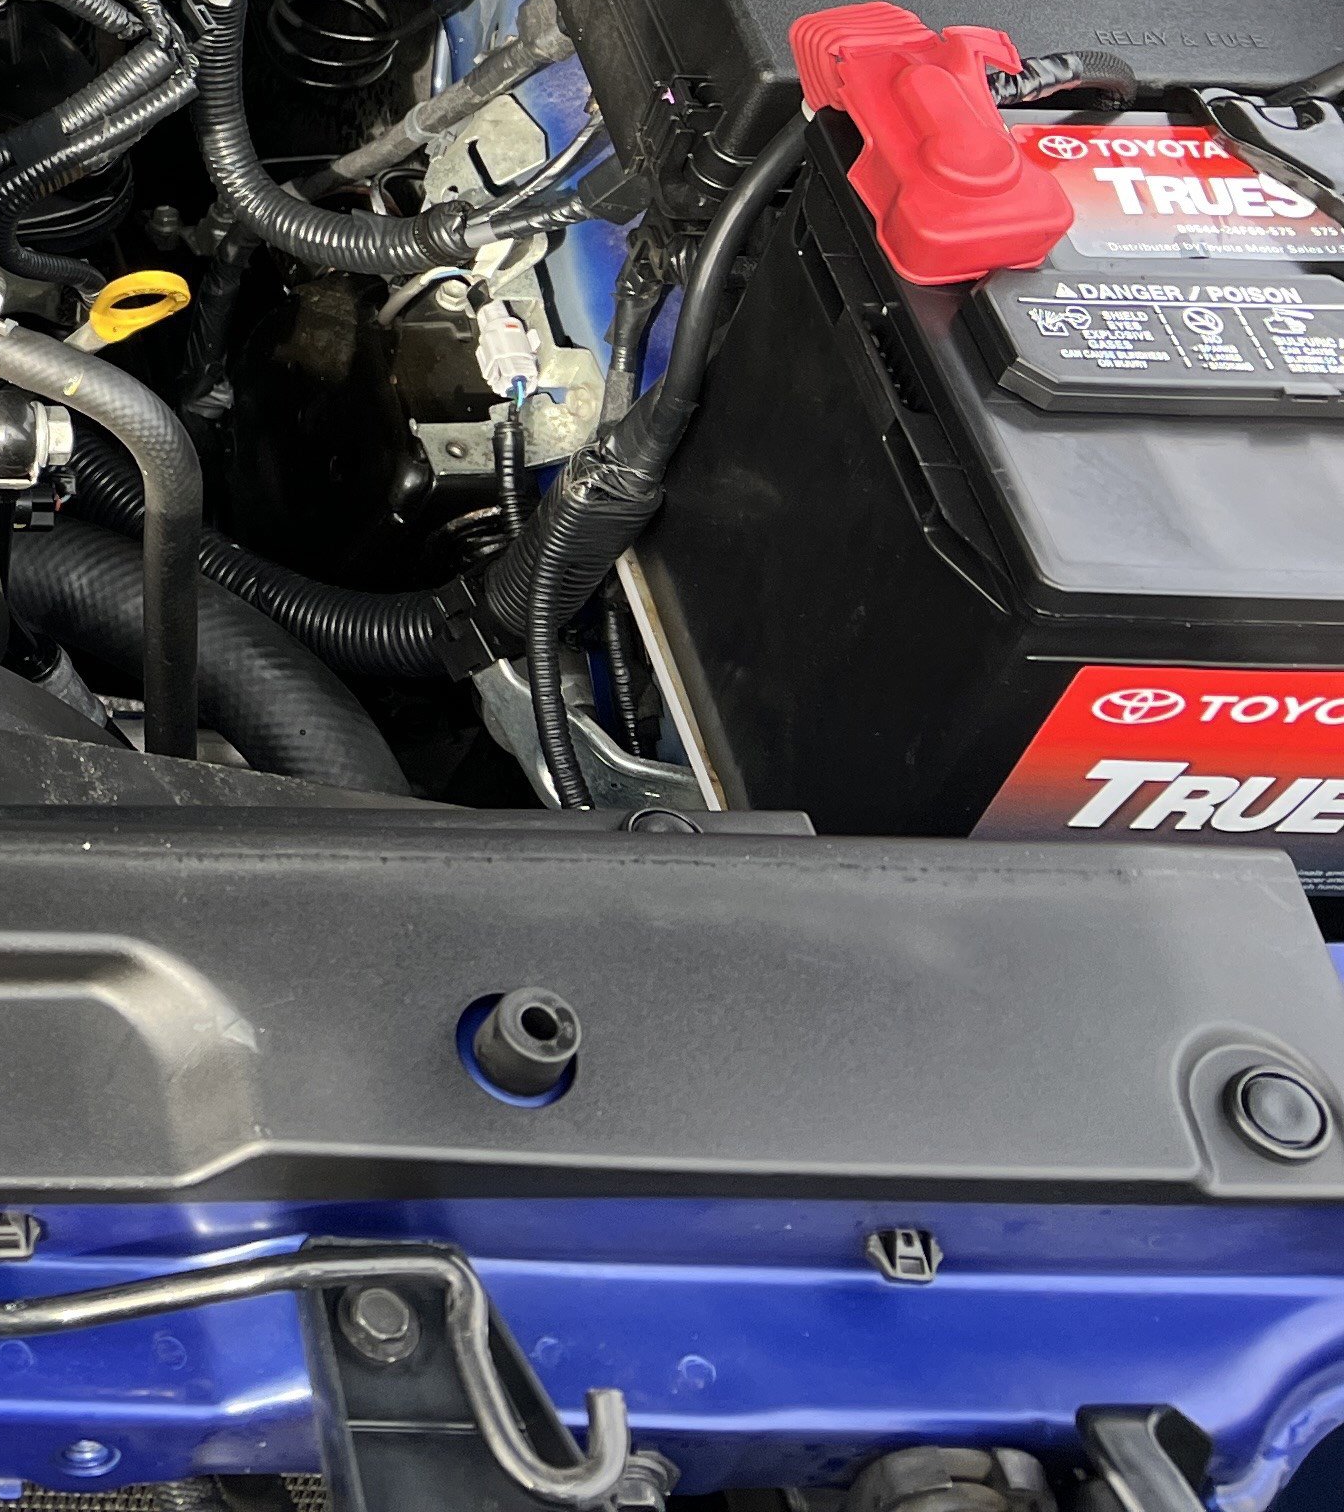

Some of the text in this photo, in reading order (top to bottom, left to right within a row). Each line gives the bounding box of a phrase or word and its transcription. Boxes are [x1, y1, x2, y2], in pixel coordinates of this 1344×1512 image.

[1095, 31, 1269, 49] RELAY & FUSE
[1088, 139, 1229, 159] TOYOTA
[1108, 241, 1180, 253] Distributed
[1184, 242, 1200, 255] by
[1200, 242, 1243, 255] Toyota
[1246, 242, 1285, 254] Motor
[1290, 242, 1324, 255] Sales
[1078, 283, 1184, 302] DANGER
[1205, 286, 1303, 304] POISON
[1101, 310, 1149, 322] SHIELD
[1200, 696, 1344, 725] TOYO
[1067, 759, 1344, 834] TRUE
